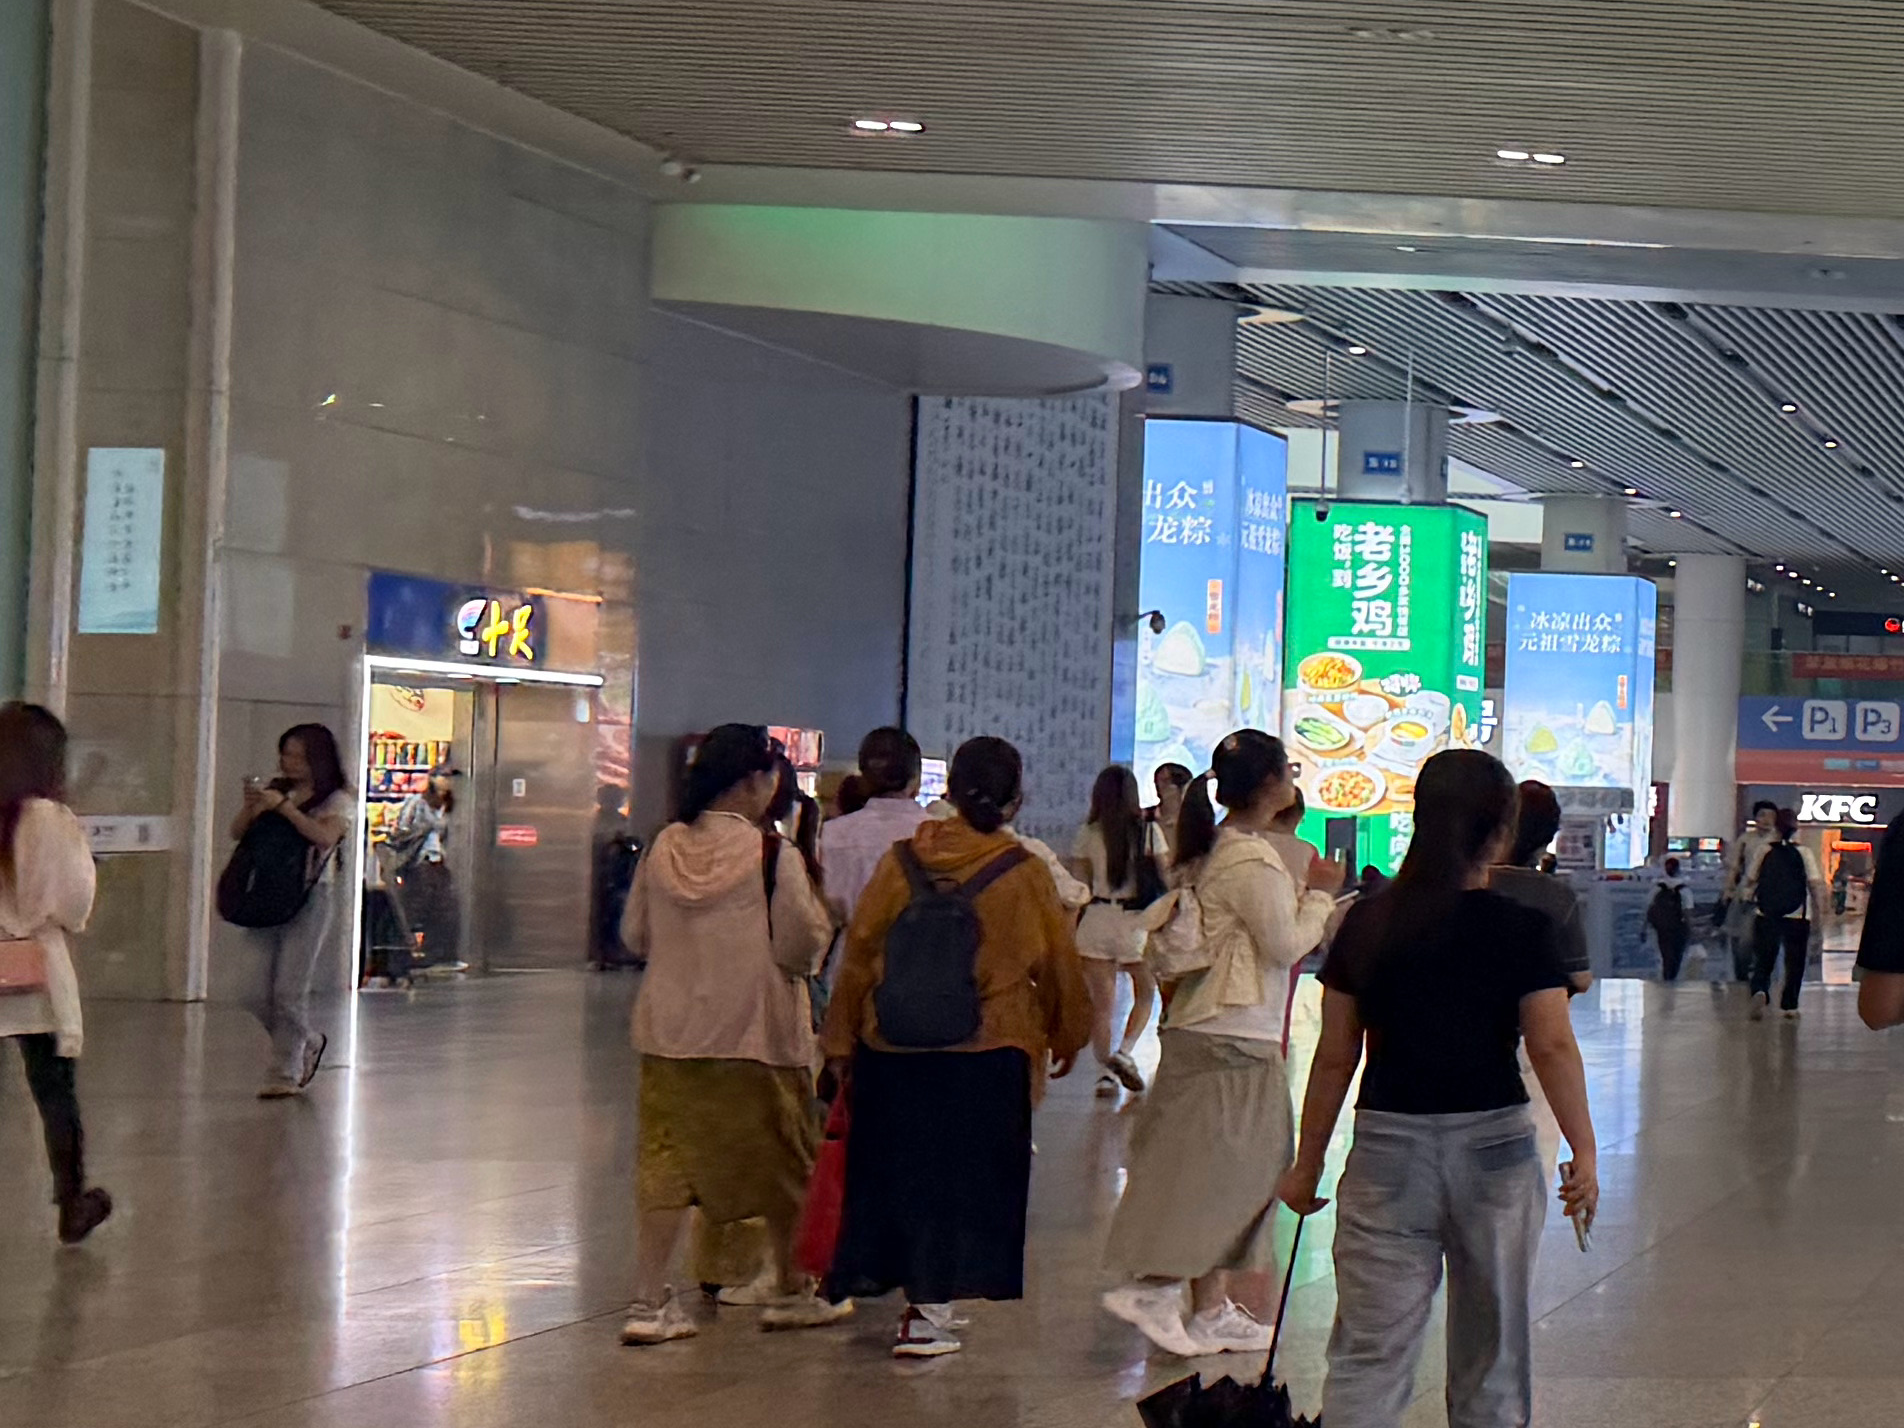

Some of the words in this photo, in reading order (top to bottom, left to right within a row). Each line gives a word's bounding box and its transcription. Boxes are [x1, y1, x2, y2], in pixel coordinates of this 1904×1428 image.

[1352, 522, 1395, 636] 老乡鸡
[1530, 611, 1613, 632] 冰凉出众
[1797, 794, 1877, 823] KFC
